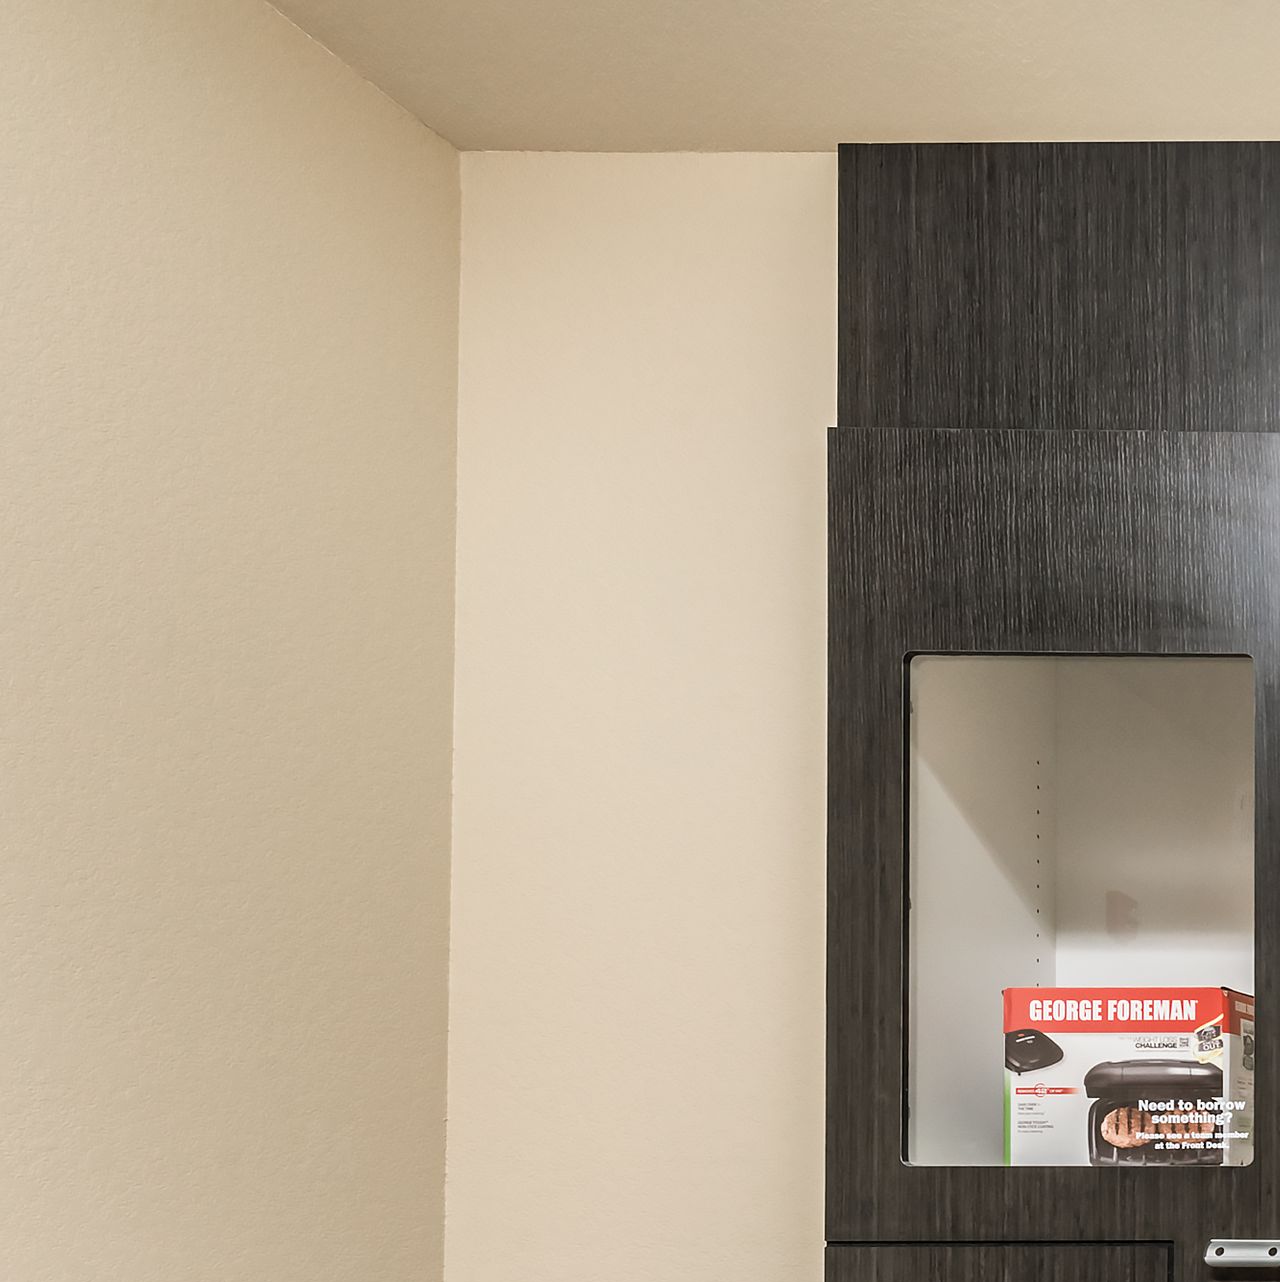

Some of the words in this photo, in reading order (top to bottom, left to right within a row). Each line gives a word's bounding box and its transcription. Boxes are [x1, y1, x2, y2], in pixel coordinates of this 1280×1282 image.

[1029, 1000, 1102, 1021] GEORGE
[1107, 999, 1196, 1021] FOREMAN
[1138, 1099, 1175, 1111] Need
[1177, 1100, 1193, 1111] to
[1196, 1099, 1246, 1111] borrow
[1151, 1112, 1233, 1125] something?
